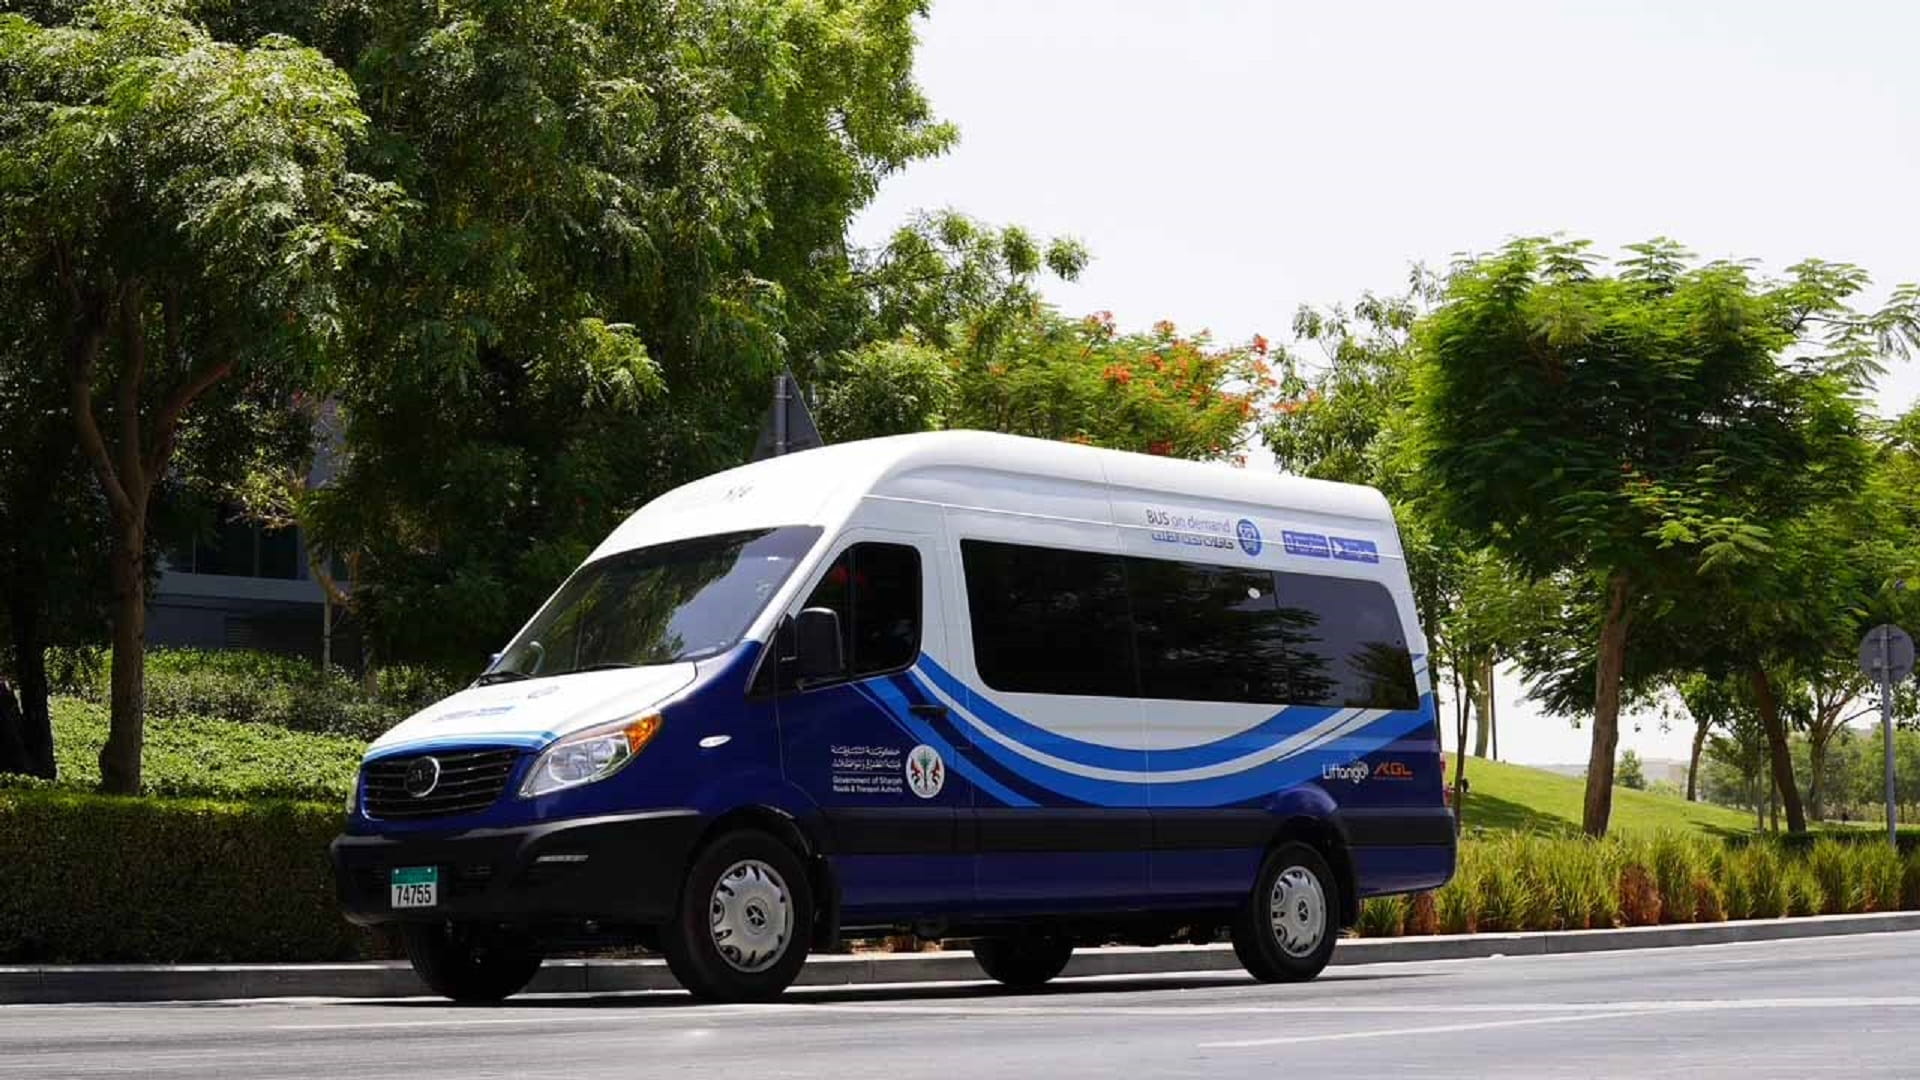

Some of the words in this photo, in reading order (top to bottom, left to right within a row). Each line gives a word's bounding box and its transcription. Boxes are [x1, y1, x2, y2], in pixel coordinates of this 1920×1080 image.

[1146, 509, 1170, 526] BUS
[1172, 516, 1187, 529] on
[1188, 514, 1231, 533] demand
[833, 776, 870, 785] Government
[872, 776, 879, 785] of
[1322, 762, 1367, 784] Liftango
[396, 884, 432, 905] 74755
